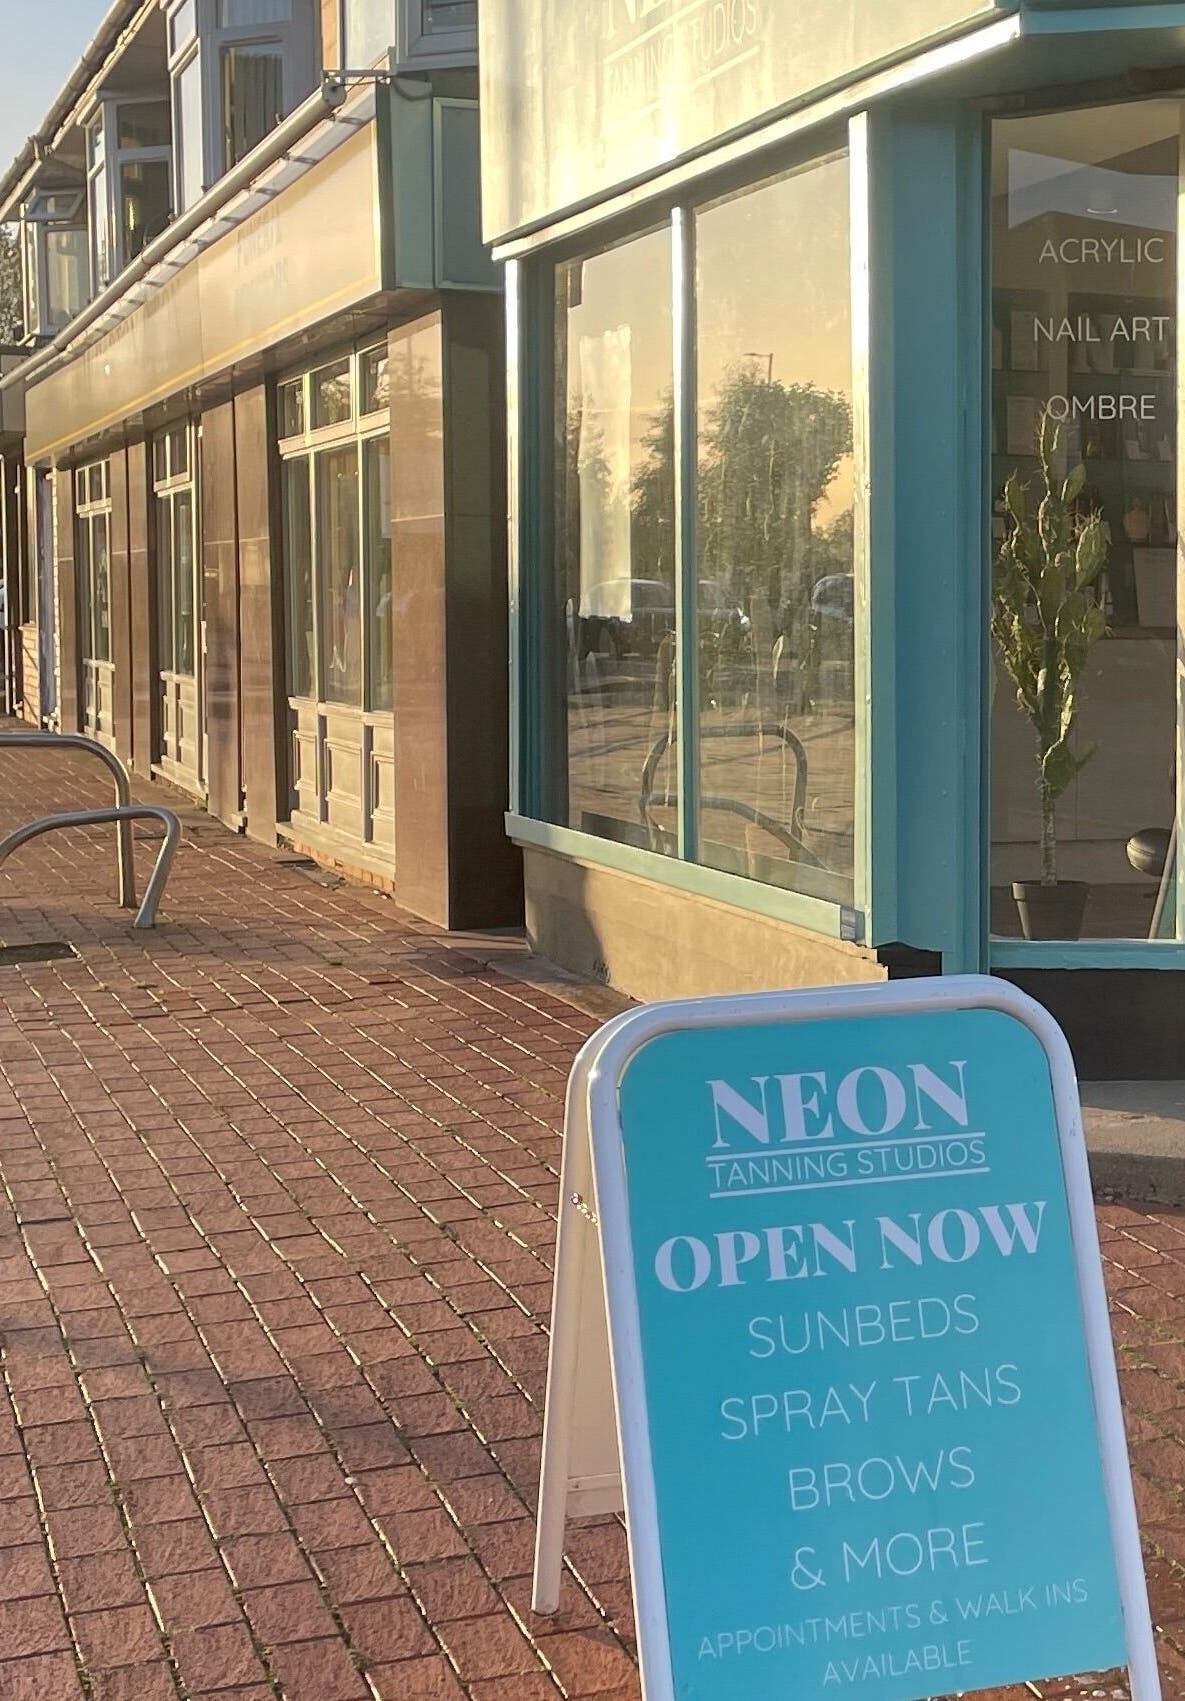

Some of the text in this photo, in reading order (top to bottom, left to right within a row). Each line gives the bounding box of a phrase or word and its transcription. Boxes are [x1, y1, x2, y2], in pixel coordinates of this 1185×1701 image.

[1038, 237, 1165, 264] ACRYLIC
[1034, 316, 1170, 342] NAIL ART
[1046, 394, 1157, 421] OMBRE
[705, 1060, 969, 1149] NEON
[708, 1139, 987, 1189] TANNING STUDIOS
[654, 1200, 1048, 1293] OPEN NOW
[748, 1293, 980, 1359] SUNBEDS
[720, 1364, 1022, 1441] SPRAY TANS
[788, 1446, 976, 1512] BROWS
[790, 1521, 989, 1591] & MORE
[698, 1577, 1089, 1662] APPOINTMENTS & WALK INS
[822, 1639, 974, 1687] AVAILABLE
